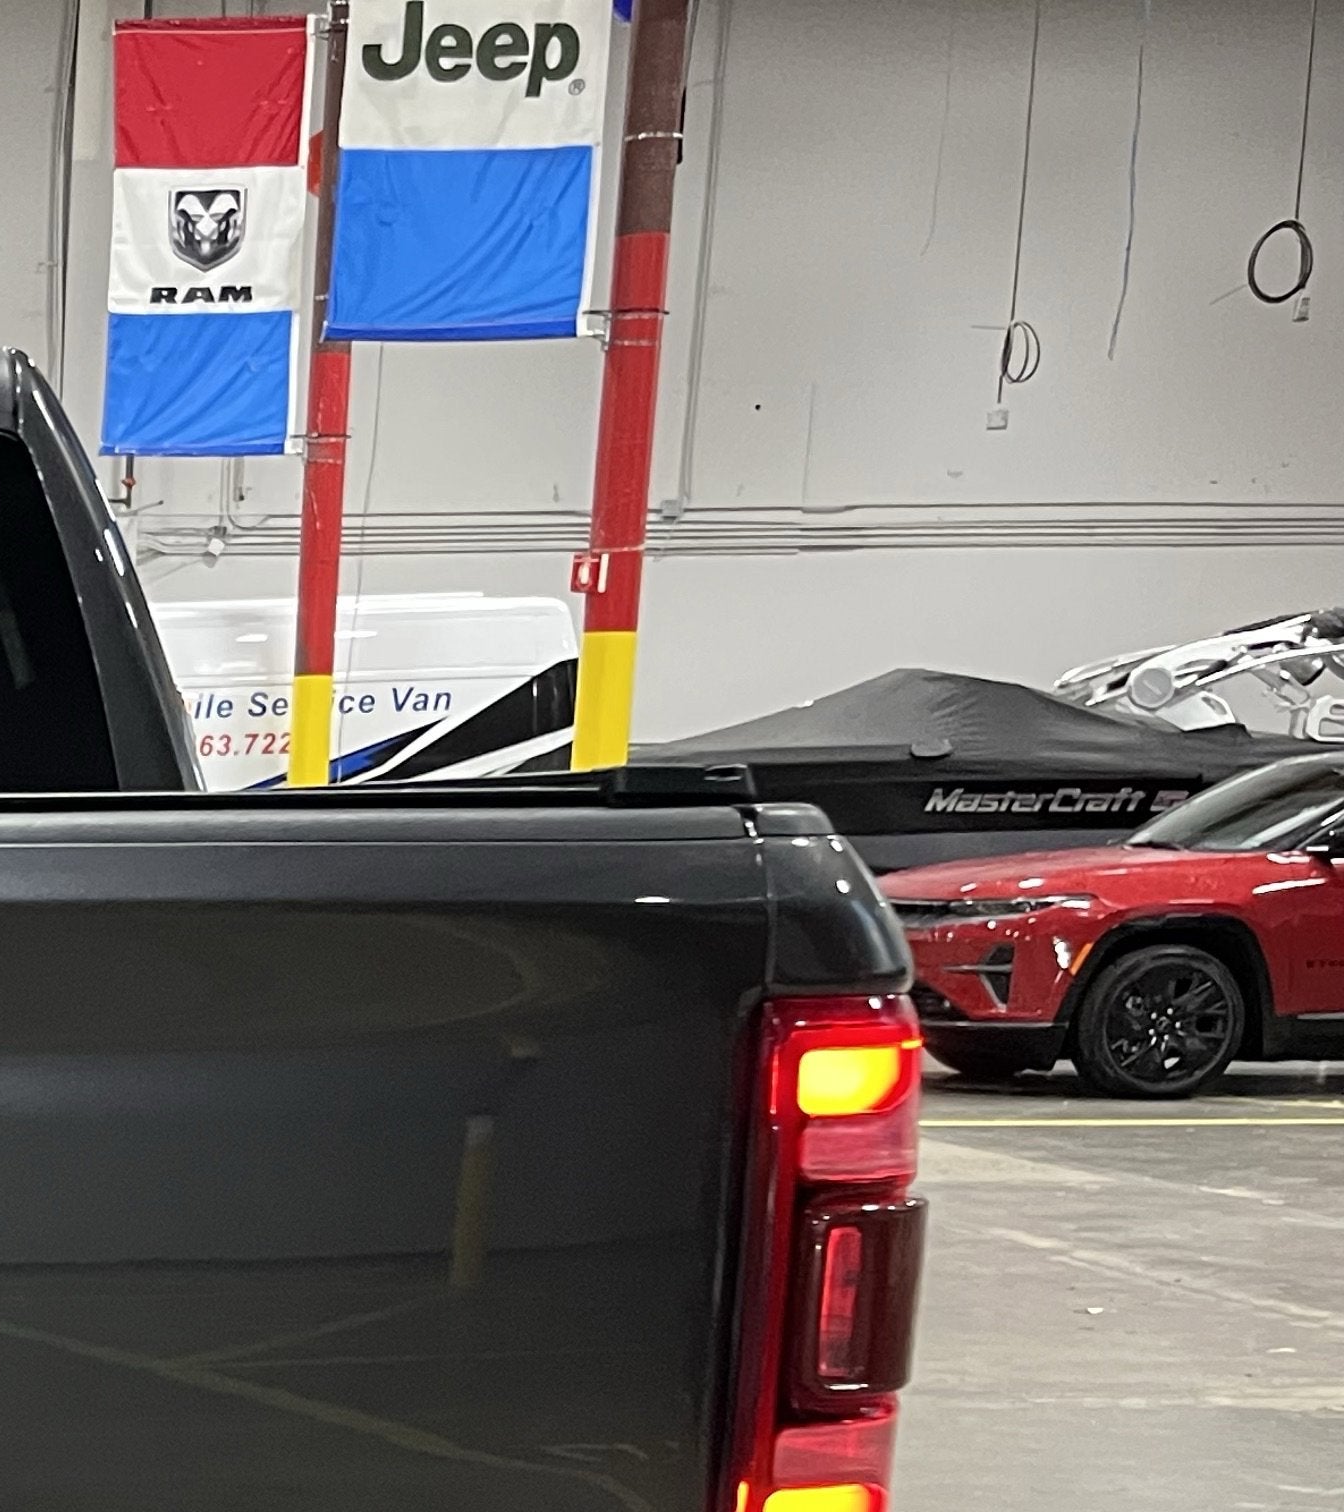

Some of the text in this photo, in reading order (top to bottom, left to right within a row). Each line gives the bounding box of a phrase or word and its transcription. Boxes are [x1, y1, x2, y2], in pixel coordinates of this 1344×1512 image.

[362, 0, 580, 97] Jeep
[150, 286, 252, 305] RAM
[392, 687, 452, 712] Van
[924, 787, 1146, 812] MasterCraft
